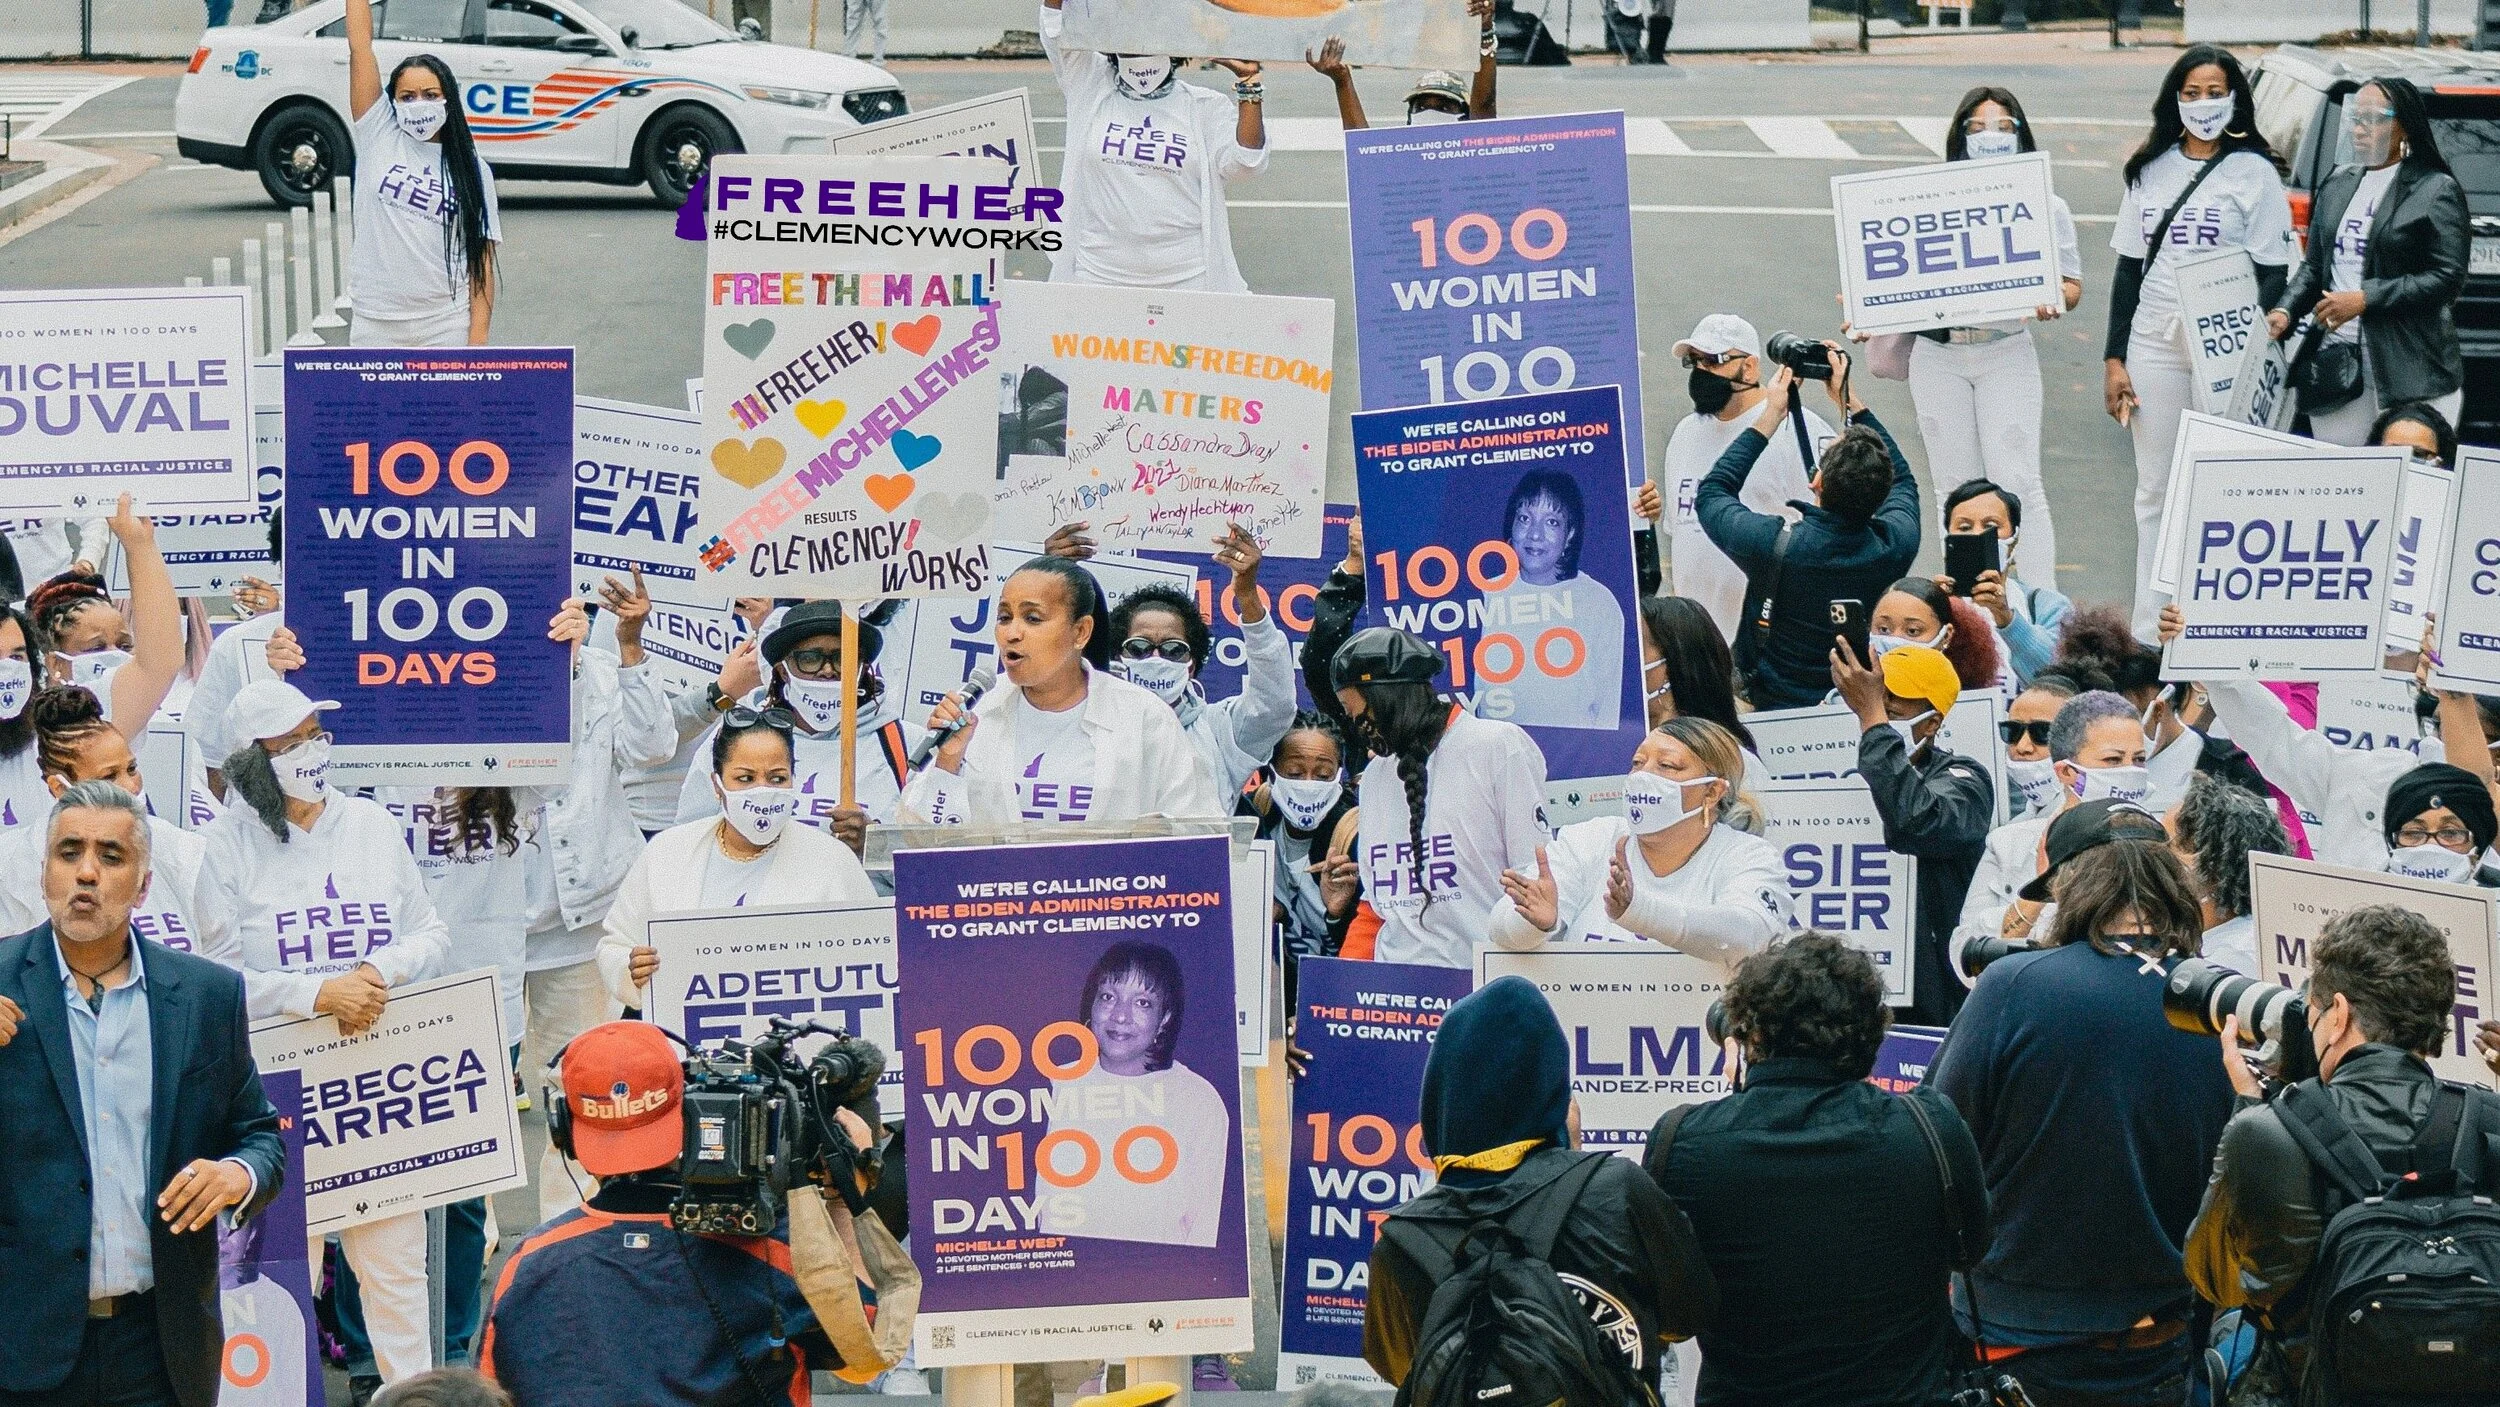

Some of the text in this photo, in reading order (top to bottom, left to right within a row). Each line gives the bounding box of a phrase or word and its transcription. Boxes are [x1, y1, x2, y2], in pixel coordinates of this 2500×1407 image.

[261, 68, 272, 76] DC
[1128, 67, 1160, 78] FreeHer
[403, 114, 437, 126] FreeHer
[889, 137, 929, 151] WOMEN
[1106, 122, 1188, 148] FREE
[1394, 127, 1617, 152] CALLING ON ADMINISTRATION
[1101, 135, 1187, 169] HER
[1438, 145, 1538, 159] GRANT CLEMENCY
[1860, 202, 2034, 241] ROBERTA
[1411, 208, 1568, 269] 100
[1863, 226, 2042, 281] BELL
[712, 272, 805, 307] FREE
[811, 272, 913, 307] THEM
[1390, 266, 1598, 312] WOMEN
[33, 325, 199, 338] WOMEN IN 100 DAYS
[1472, 310, 1523, 344] IN
[332, 360, 568, 371] CALLING ON THE BIDEN ADMINISTRATION
[360, 372, 503, 382] TO GRANT CLEMENCY TO
[1419, 344, 1576, 405] 100
[1102, 384, 1264, 426] MATTERS
[1402, 410, 1567, 439] WE'RE CALLING ON
[580, 431, 680, 453] WOMEN IN 100
[1125, 423, 1232, 457] Cassandra
[1363, 422, 1610, 459] THE BIDEN ADMINISTRATION
[68, 459, 230, 475] IS RACIAL JUSTICE.
[345, 440, 511, 497] 100
[1380, 440, 1595, 475] TO GRANT CLEMENCY TO
[2245, 486, 2365, 498] WOMEN DAYS
[318, 506, 537, 540] WOMEN
[803, 510, 858, 526] RESULTS
[1150, 503, 1188, 523] Wendy
[2197, 518, 2380, 565] POLLY
[402, 547, 456, 579] IN
[881, 543, 990, 594] WORKS!
[1376, 540, 1521, 601] 100
[2192, 566, 2374, 601] HOPPER
[343, 585, 509, 643] 100
[1382, 589, 1575, 635] WOMEN
[2185, 626, 2367, 638] CLEMENCY IS RACIAL JUSTICE.
[358, 651, 498, 686] DAYS
[1441, 626, 1587, 687] 100
[1132, 673, 1176, 692] FreeHer
[1769, 740, 1858, 756] 100 WOMEN
[393, 760, 430, 770] RACIAL
[742, 799, 786, 816] FreeHer
[1806, 816, 1871, 827] 100 DAYS
[2400, 864, 2450, 880] FreeHer
[958, 874, 1167, 899] WE'RE CALLING ON
[275, 902, 392, 935] FREE
[905, 892, 1221, 921] THE BIDEN ADMINISTRATION
[926, 912, 1201, 940] TO GRANT CLEMENCY TO
[695, 935, 892, 956] 100 WOMEN IN 100 DAYS
[684, 963, 901, 1001] ADETUTU
[1569, 983, 1695, 993] WOMEN IN 100
[1355, 991, 1418, 1009] WE'RE
[1310, 1005, 1411, 1026] THE BIDEN
[270, 1014, 456, 1064] 100 WOMEN IN 100 DAYS
[1325, 1022, 1423, 1042] TO GRANT
[914, 1021, 1100, 1088] 100
[581, 1087, 669, 1120] Bullets
[921, 1081, 1167, 1129] WOMEN
[348, 1158, 423, 1184] IS RACIAL
[930, 1124, 1180, 1191] IN 100
[932, 1190, 1088, 1235] DAYS
[1310, 1206, 1361, 1239] IN
[934, 1236, 1068, 1254] MICHELLE WEST
[944, 1249, 1074, 1264] DEVOTED MOTHER SERVING
[945, 1259, 1076, 1274] LIFE SENTENCES YEARS
[965, 1325, 1086, 1340] CLEMENCY RACIAL
[1477, 1382, 1513, 1400] Canon
